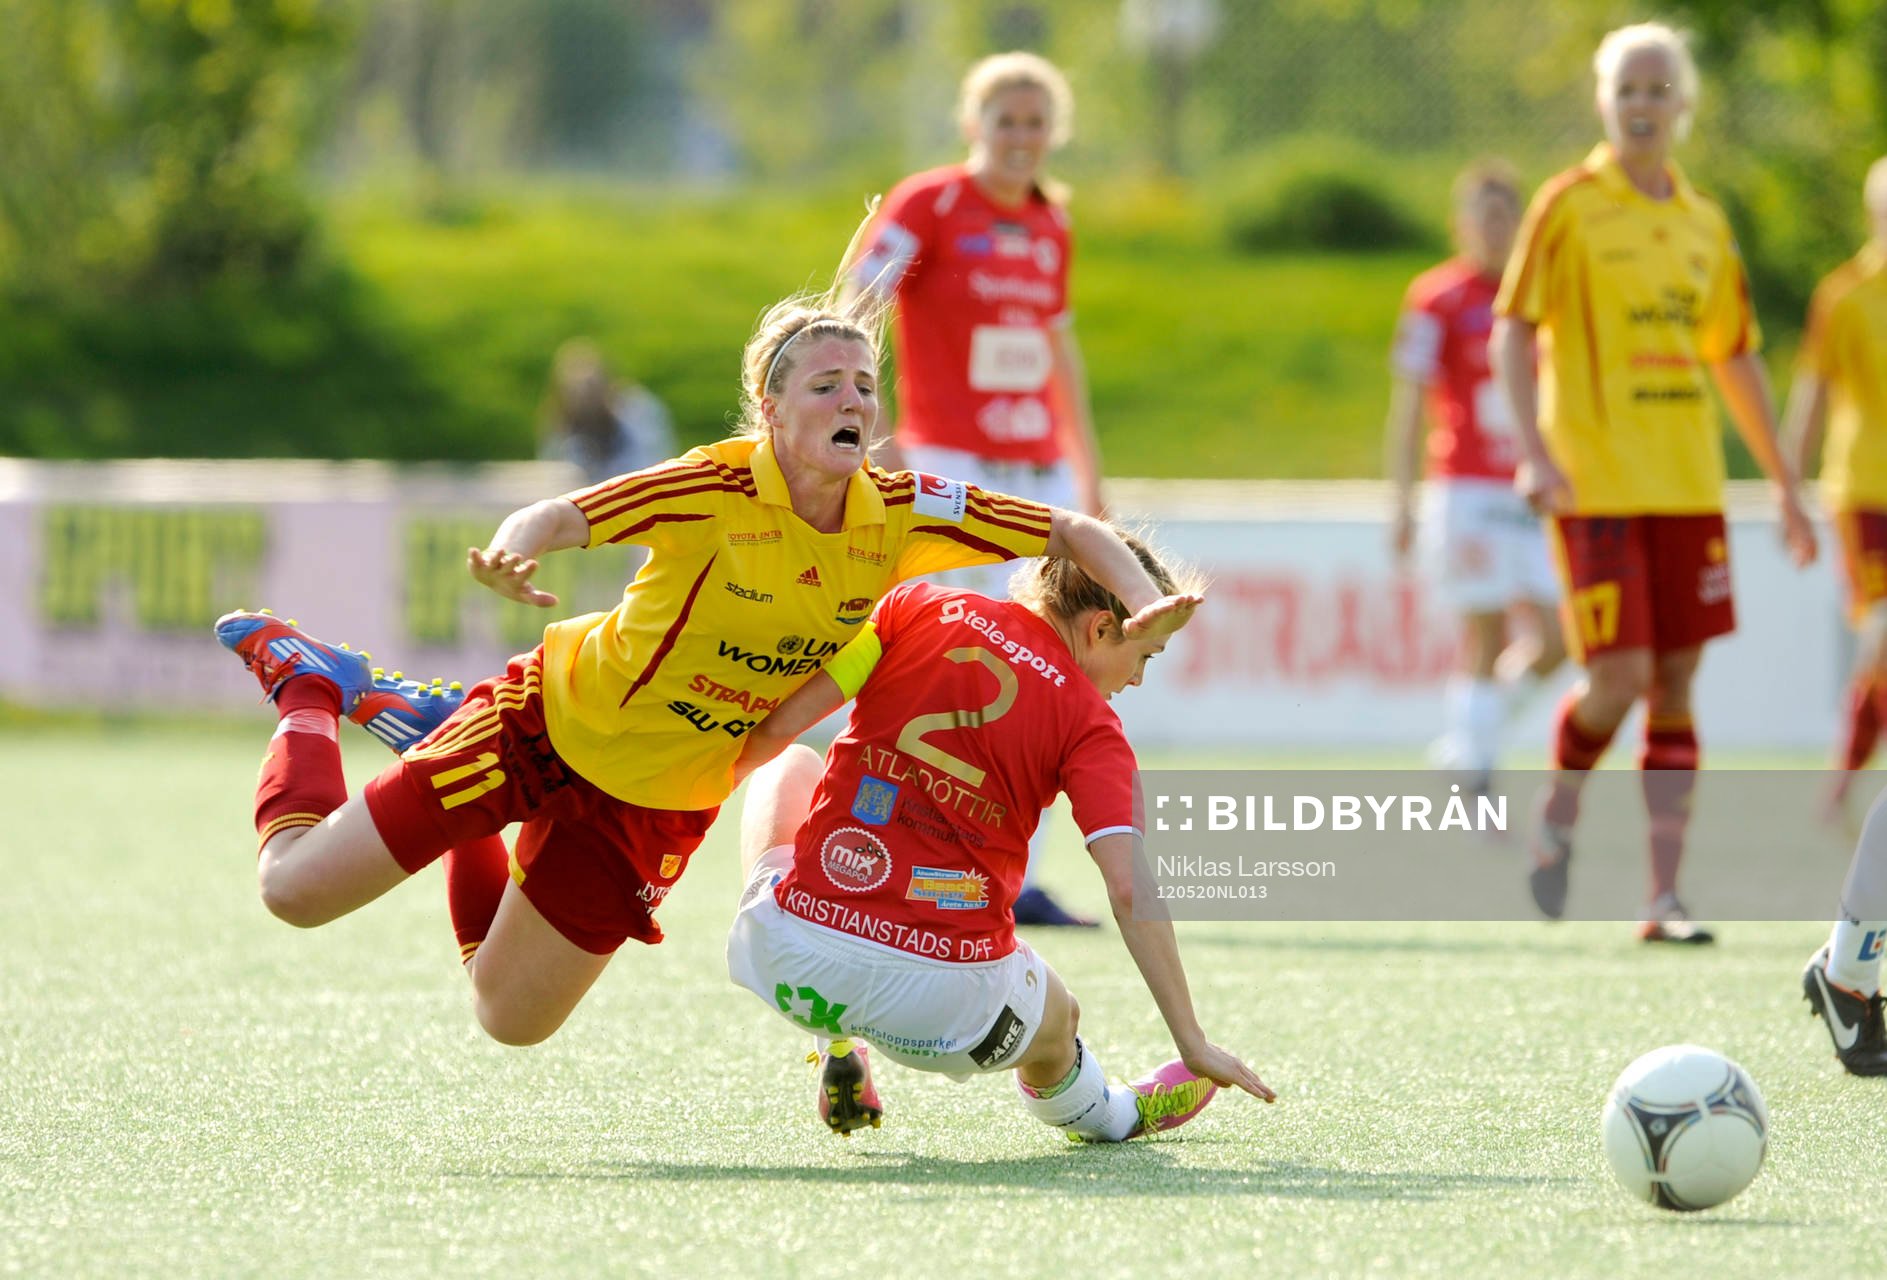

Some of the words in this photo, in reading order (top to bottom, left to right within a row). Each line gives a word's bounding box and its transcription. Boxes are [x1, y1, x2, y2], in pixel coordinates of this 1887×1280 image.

[724, 582, 774, 604] stadium
[796, 577, 822, 588] adidas
[717, 640, 822, 677] WOMEN
[803, 638, 849, 658] UN
[963, 609, 1067, 688] telesport
[895, 645, 1019, 789] 2
[430, 751, 506, 811] 11
[826, 861, 869, 884] MEGAPOL
[830, 845, 879, 877] mix
[785, 887, 953, 959] KRISTIANSTADS
[958, 937, 994, 961] DFF
